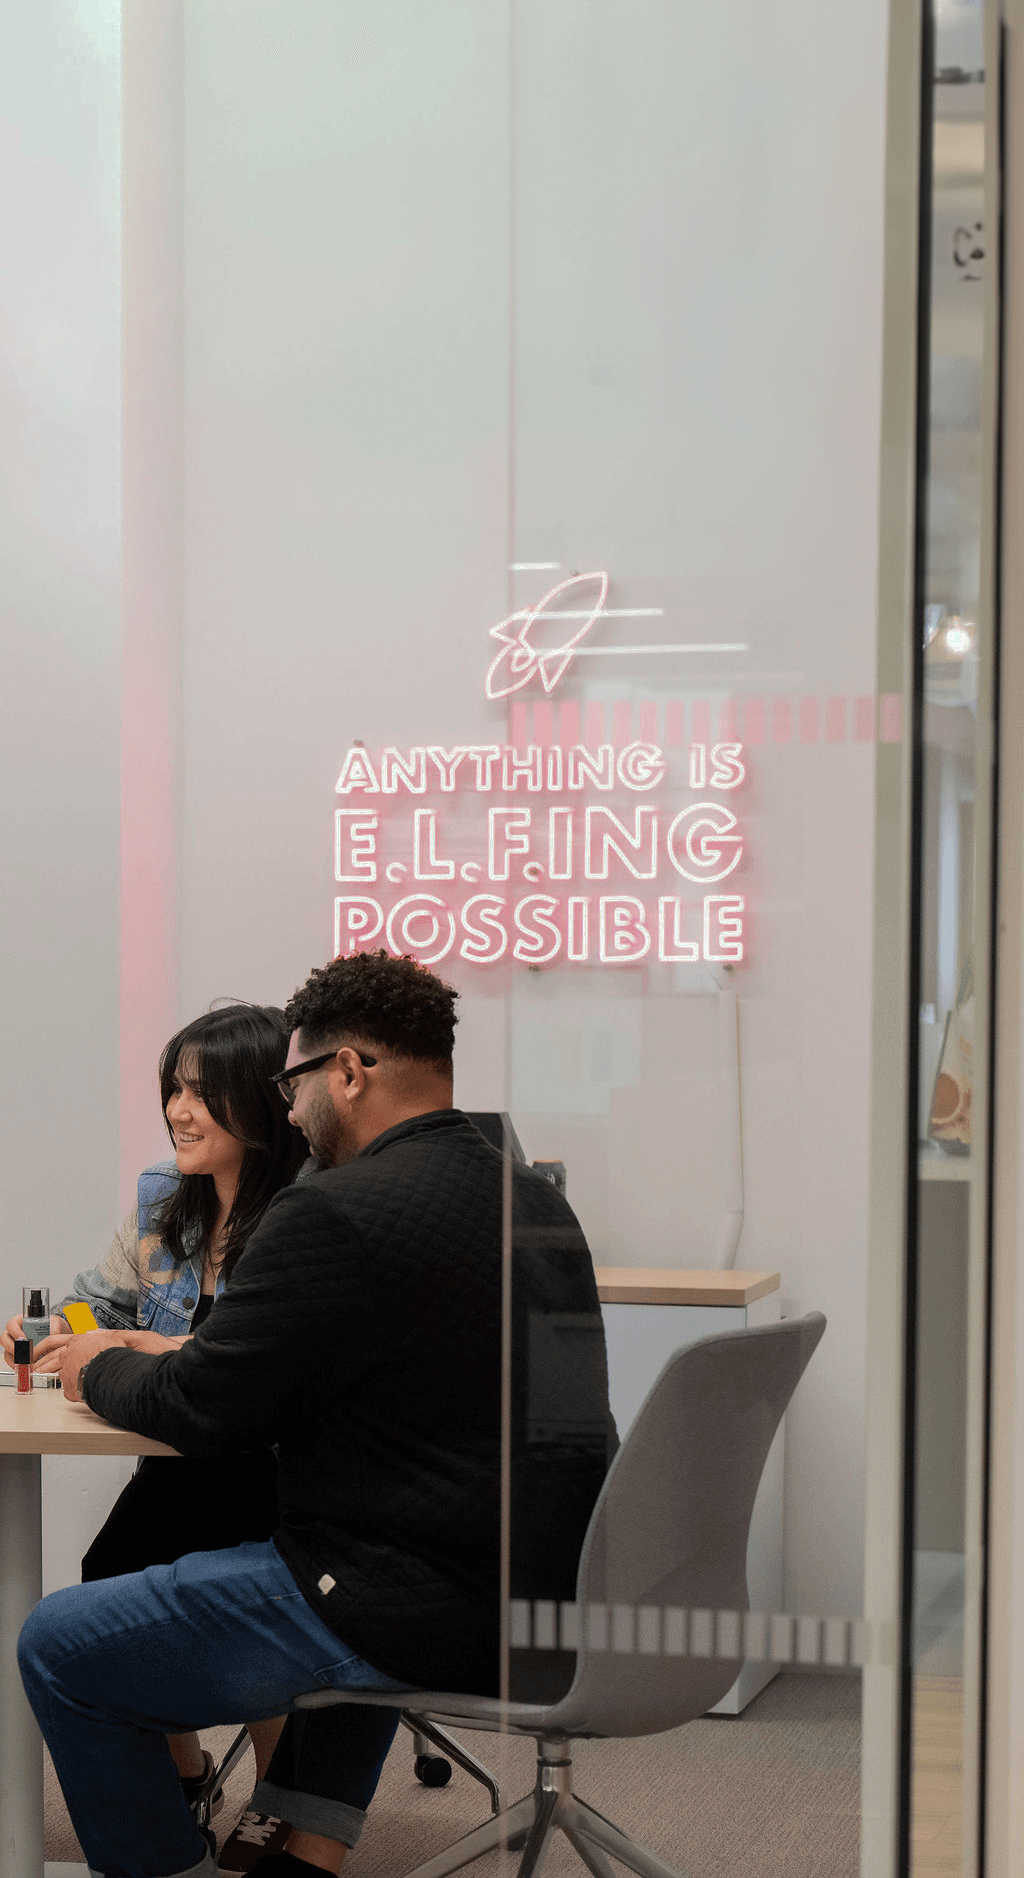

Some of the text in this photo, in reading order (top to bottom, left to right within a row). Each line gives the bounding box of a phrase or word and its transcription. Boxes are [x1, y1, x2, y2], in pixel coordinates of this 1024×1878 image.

[335, 741, 746, 793] ANYTHING IS
[334, 802, 744, 883] E.L.F.ING
[334, 893, 745, 964] POSSIBLE
